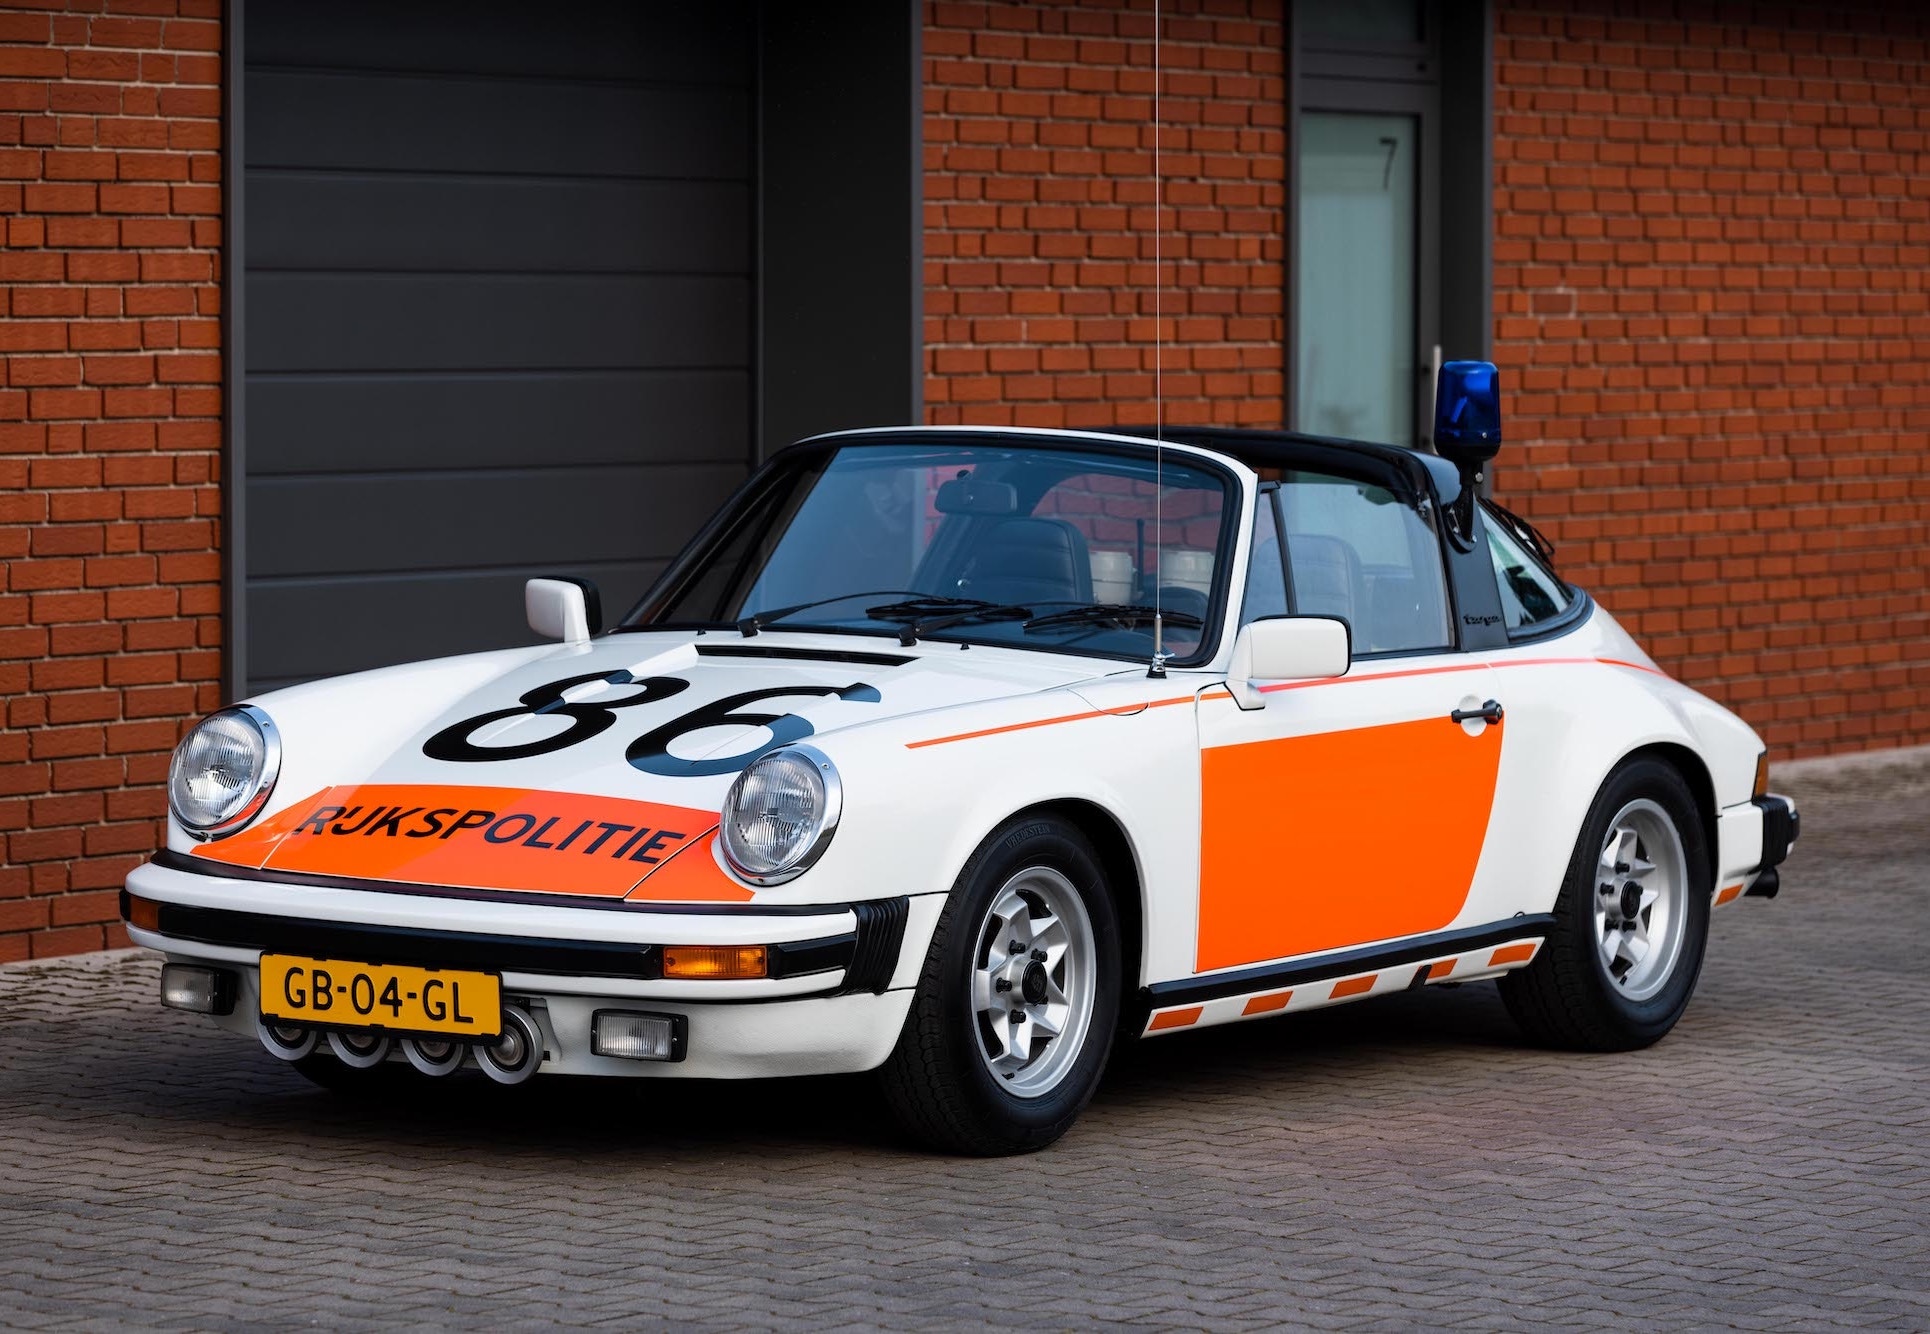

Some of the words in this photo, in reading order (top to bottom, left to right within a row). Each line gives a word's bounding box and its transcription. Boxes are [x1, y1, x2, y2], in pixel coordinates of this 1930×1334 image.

[1379, 137, 1398, 191] 7
[422, 669, 881, 777] 86
[284, 967, 474, 1024] GB-04-GL
